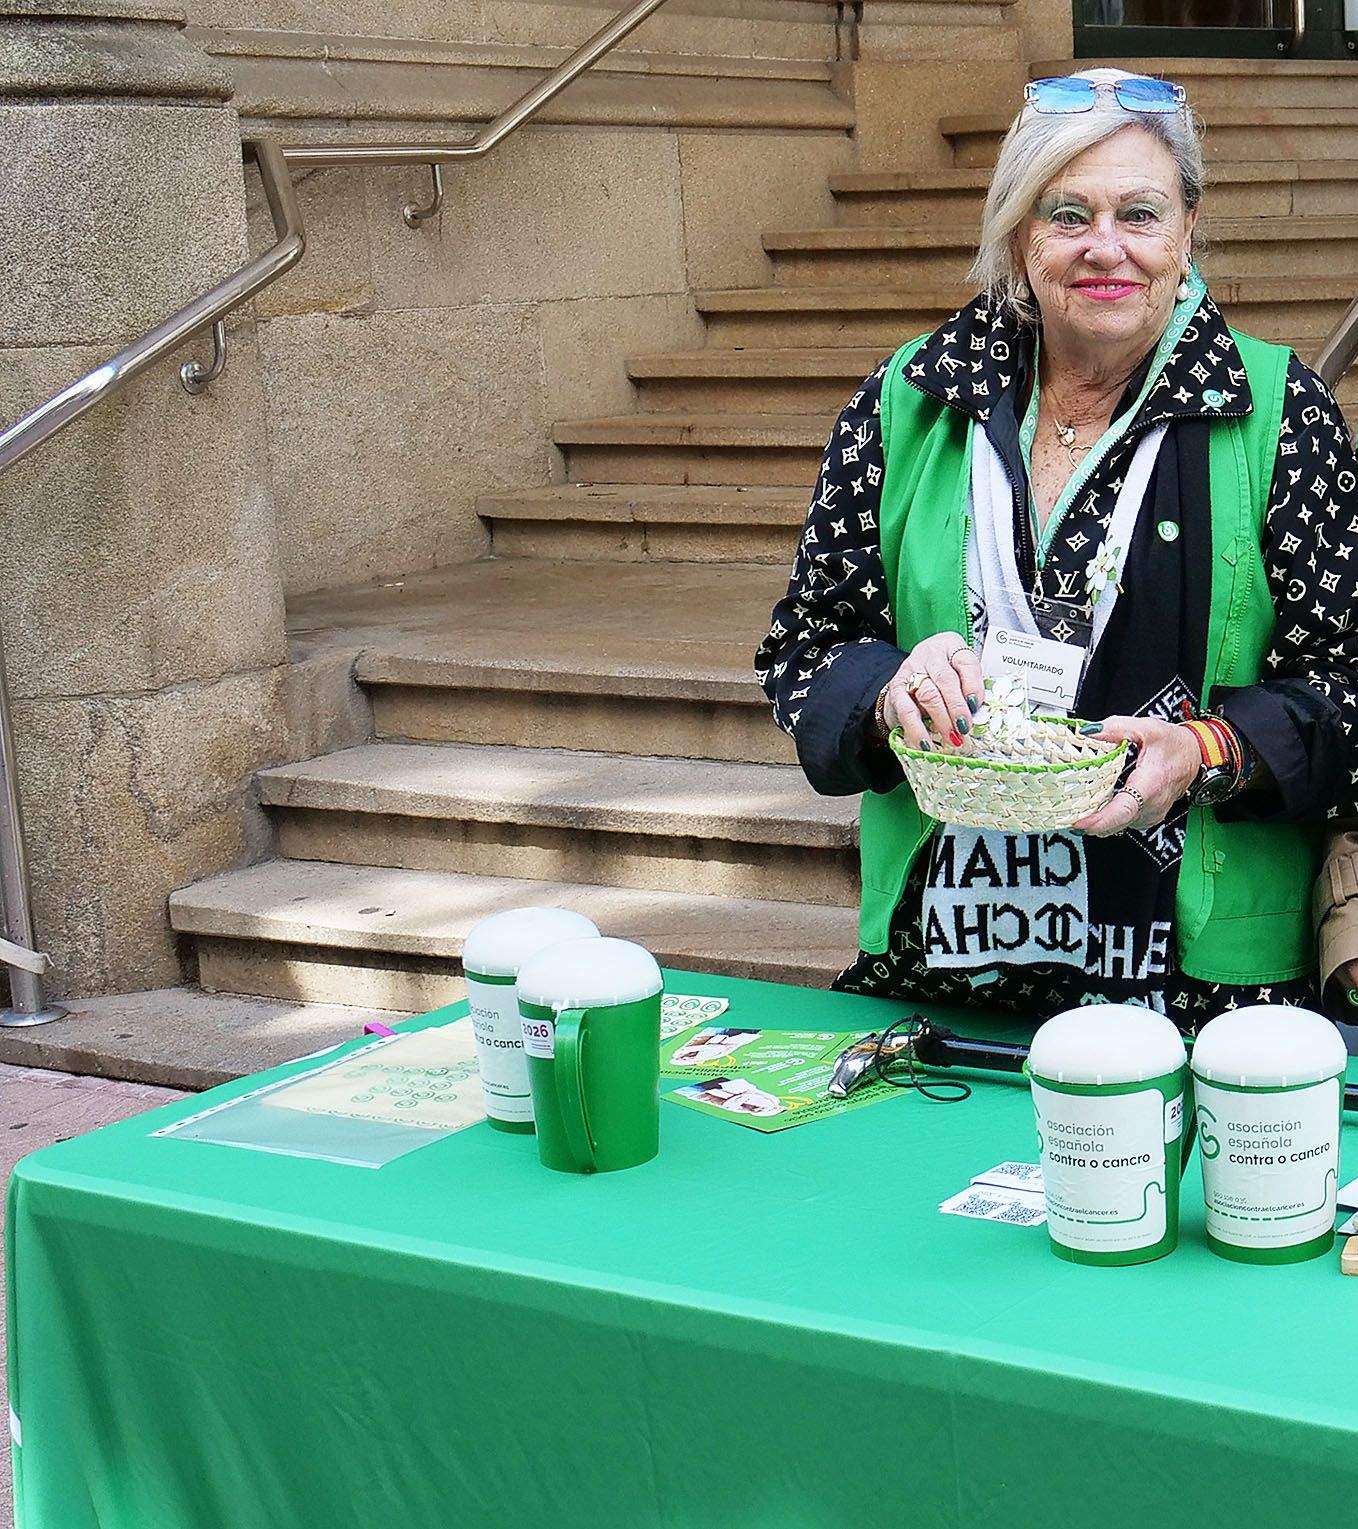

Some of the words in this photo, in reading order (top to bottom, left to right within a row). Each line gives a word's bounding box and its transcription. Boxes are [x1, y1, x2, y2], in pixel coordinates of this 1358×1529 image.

[1002, 655, 1063, 675] VOLUNTARIADO
[523, 1024, 550, 1038] 2026
[485, 1038, 493, 1046] o
[1047, 1119, 1115, 1137] asociación
[1227, 1119, 1302, 1133] asociación
[1048, 1135, 1105, 1152] española
[1228, 1137, 1292, 1151] española
[1050, 1151, 1086, 1168] contra
[1090, 1158, 1099, 1168] o
[1102, 1153, 1151, 1168] cancro
[1229, 1153, 1274, 1165] contra
[1277, 1155, 1287, 1164] o
[1290, 1142, 1331, 1162] cancro
